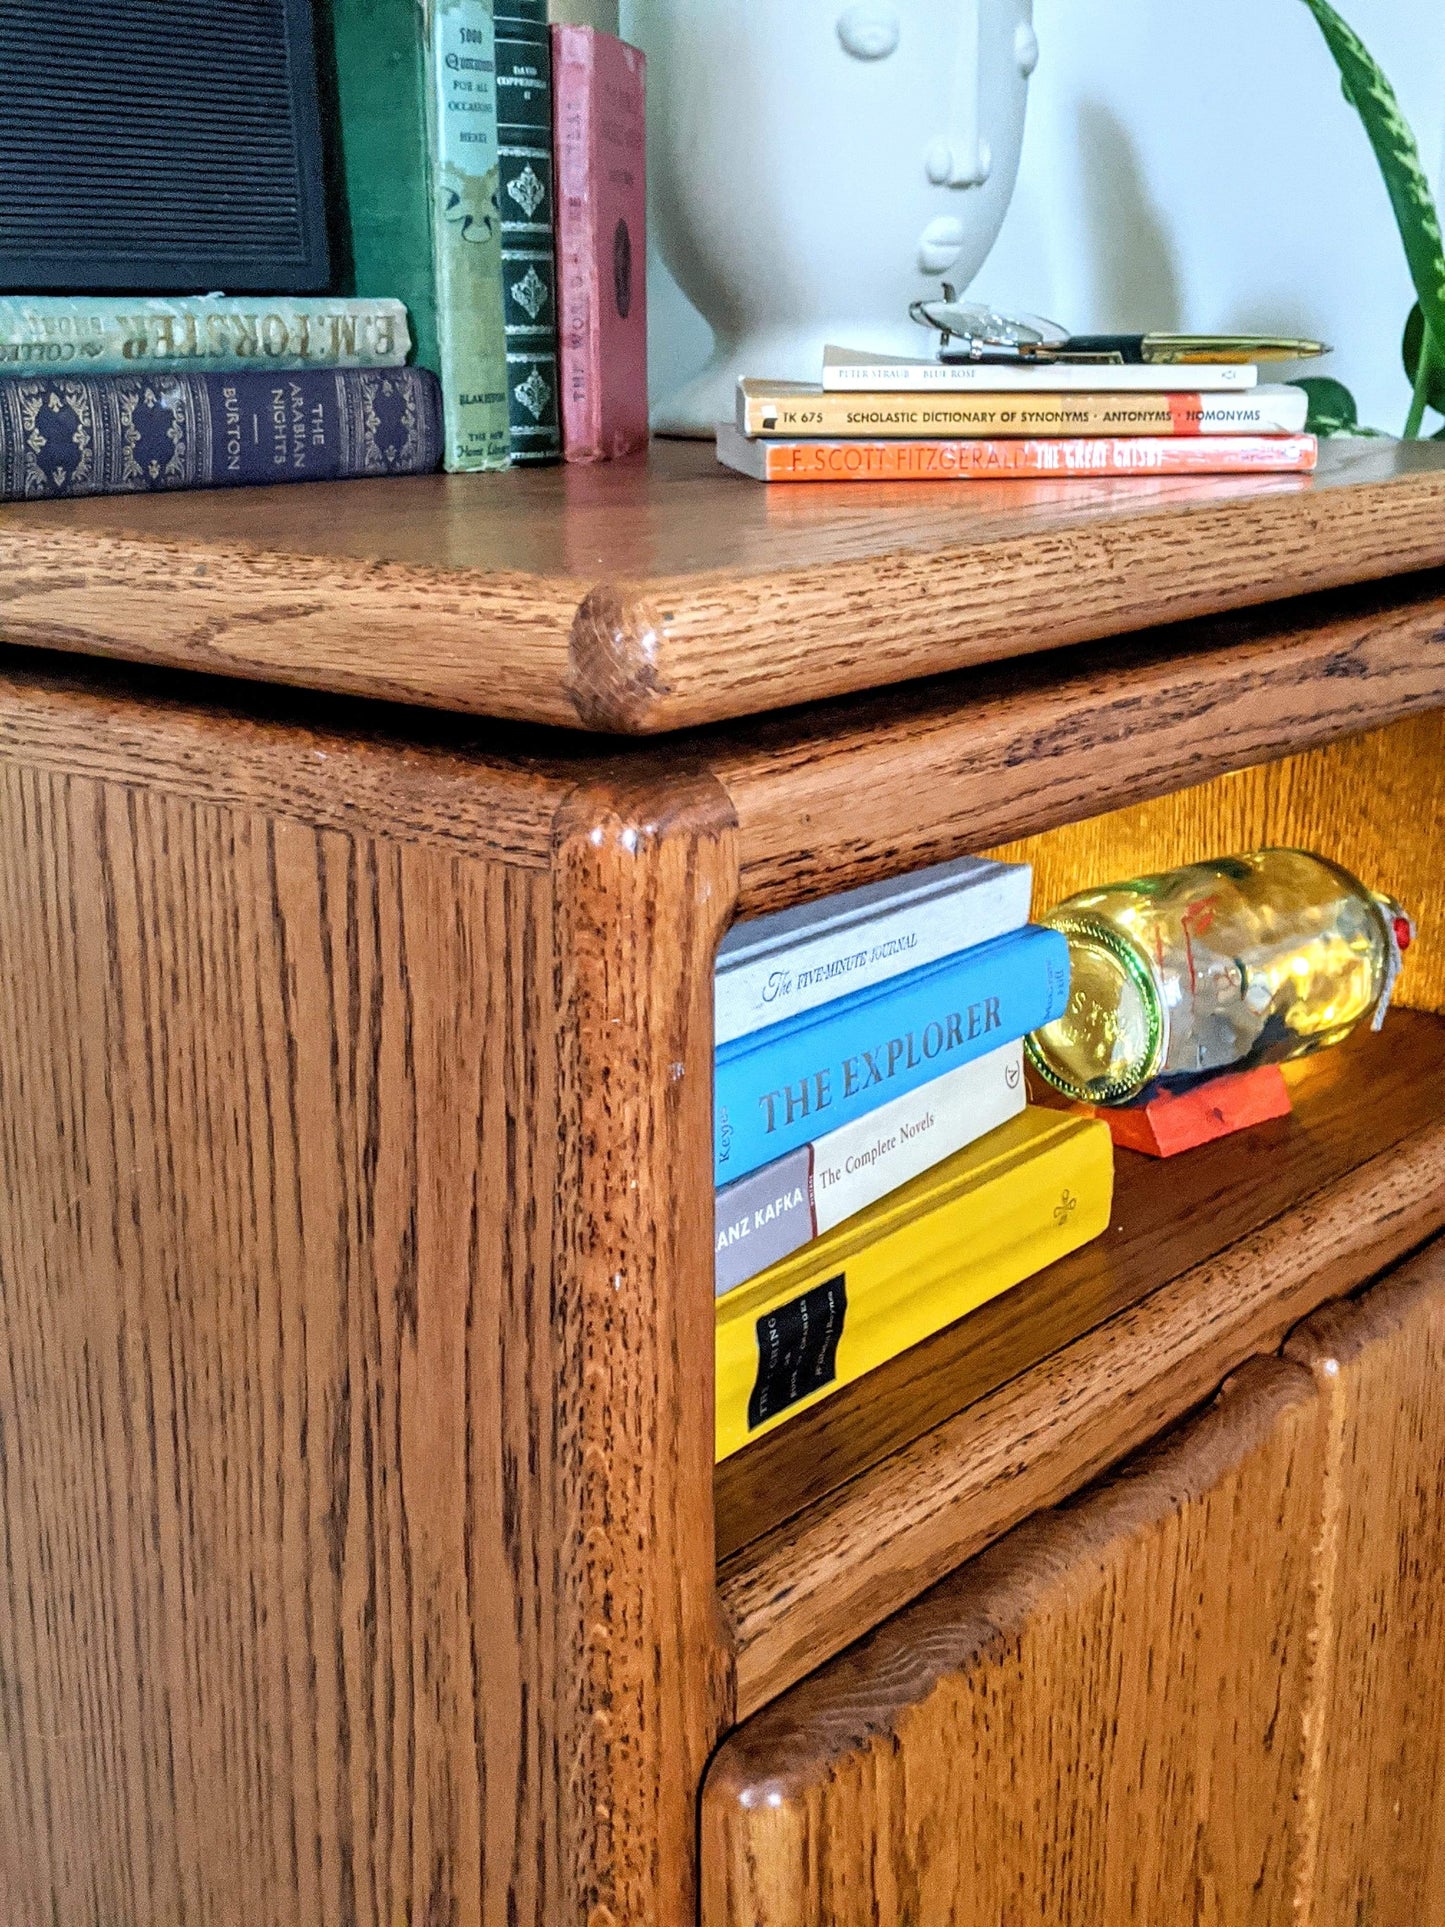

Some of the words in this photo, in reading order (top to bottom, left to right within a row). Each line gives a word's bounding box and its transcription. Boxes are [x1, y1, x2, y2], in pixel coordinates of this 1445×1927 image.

[115, 313, 312, 360] FORSTER
[872, 369, 910, 379] STRAUB
[951, 369, 977, 379] ROSE
[223, 387, 241, 470] BURTON
[271, 388, 287, 465] NIGHTS
[288, 381, 306, 468] ARABIAN
[311, 403, 325, 446] THE
[783, 412, 797, 423] TK
[801, 412, 824, 423] 675
[846, 411, 918, 423] SCHOLASTIC
[922, 411, 996, 423] DICTIONARY
[1000, 411, 1017, 422] OF
[1020, 411, 1089, 423] SYNONYMS
[1102, 410, 1172, 422] ANTONYMS
[1186, 410, 1261, 421] HOMONYMS
[792, 449, 807, 472] F.
[814, 448, 886, 471] SCOTT
[897, 447, 1028, 471] FITZGERALD
[1036, 442, 1060, 469] THE
[1063, 441, 1107, 469] GREAT
[1113, 439, 1163, 468] GATSBY
[762, 969, 793, 1002] The
[796, 950, 868, 990] FIVE-MINUTE
[870, 933, 918, 963] JOURNAL
[758, 1066, 833, 1134] THE
[841, 995, 1002, 1100] EXPLORER
[718, 1105, 735, 1164] Keyes
[819, 1168, 841, 1189] The
[845, 1137, 896, 1174] Complete
[900, 1112, 935, 1144] Novels
[715, 1217, 750, 1252] ANZ
[754, 1187, 803, 1229] KAFKA
[767, 1317, 780, 1369] CHING
